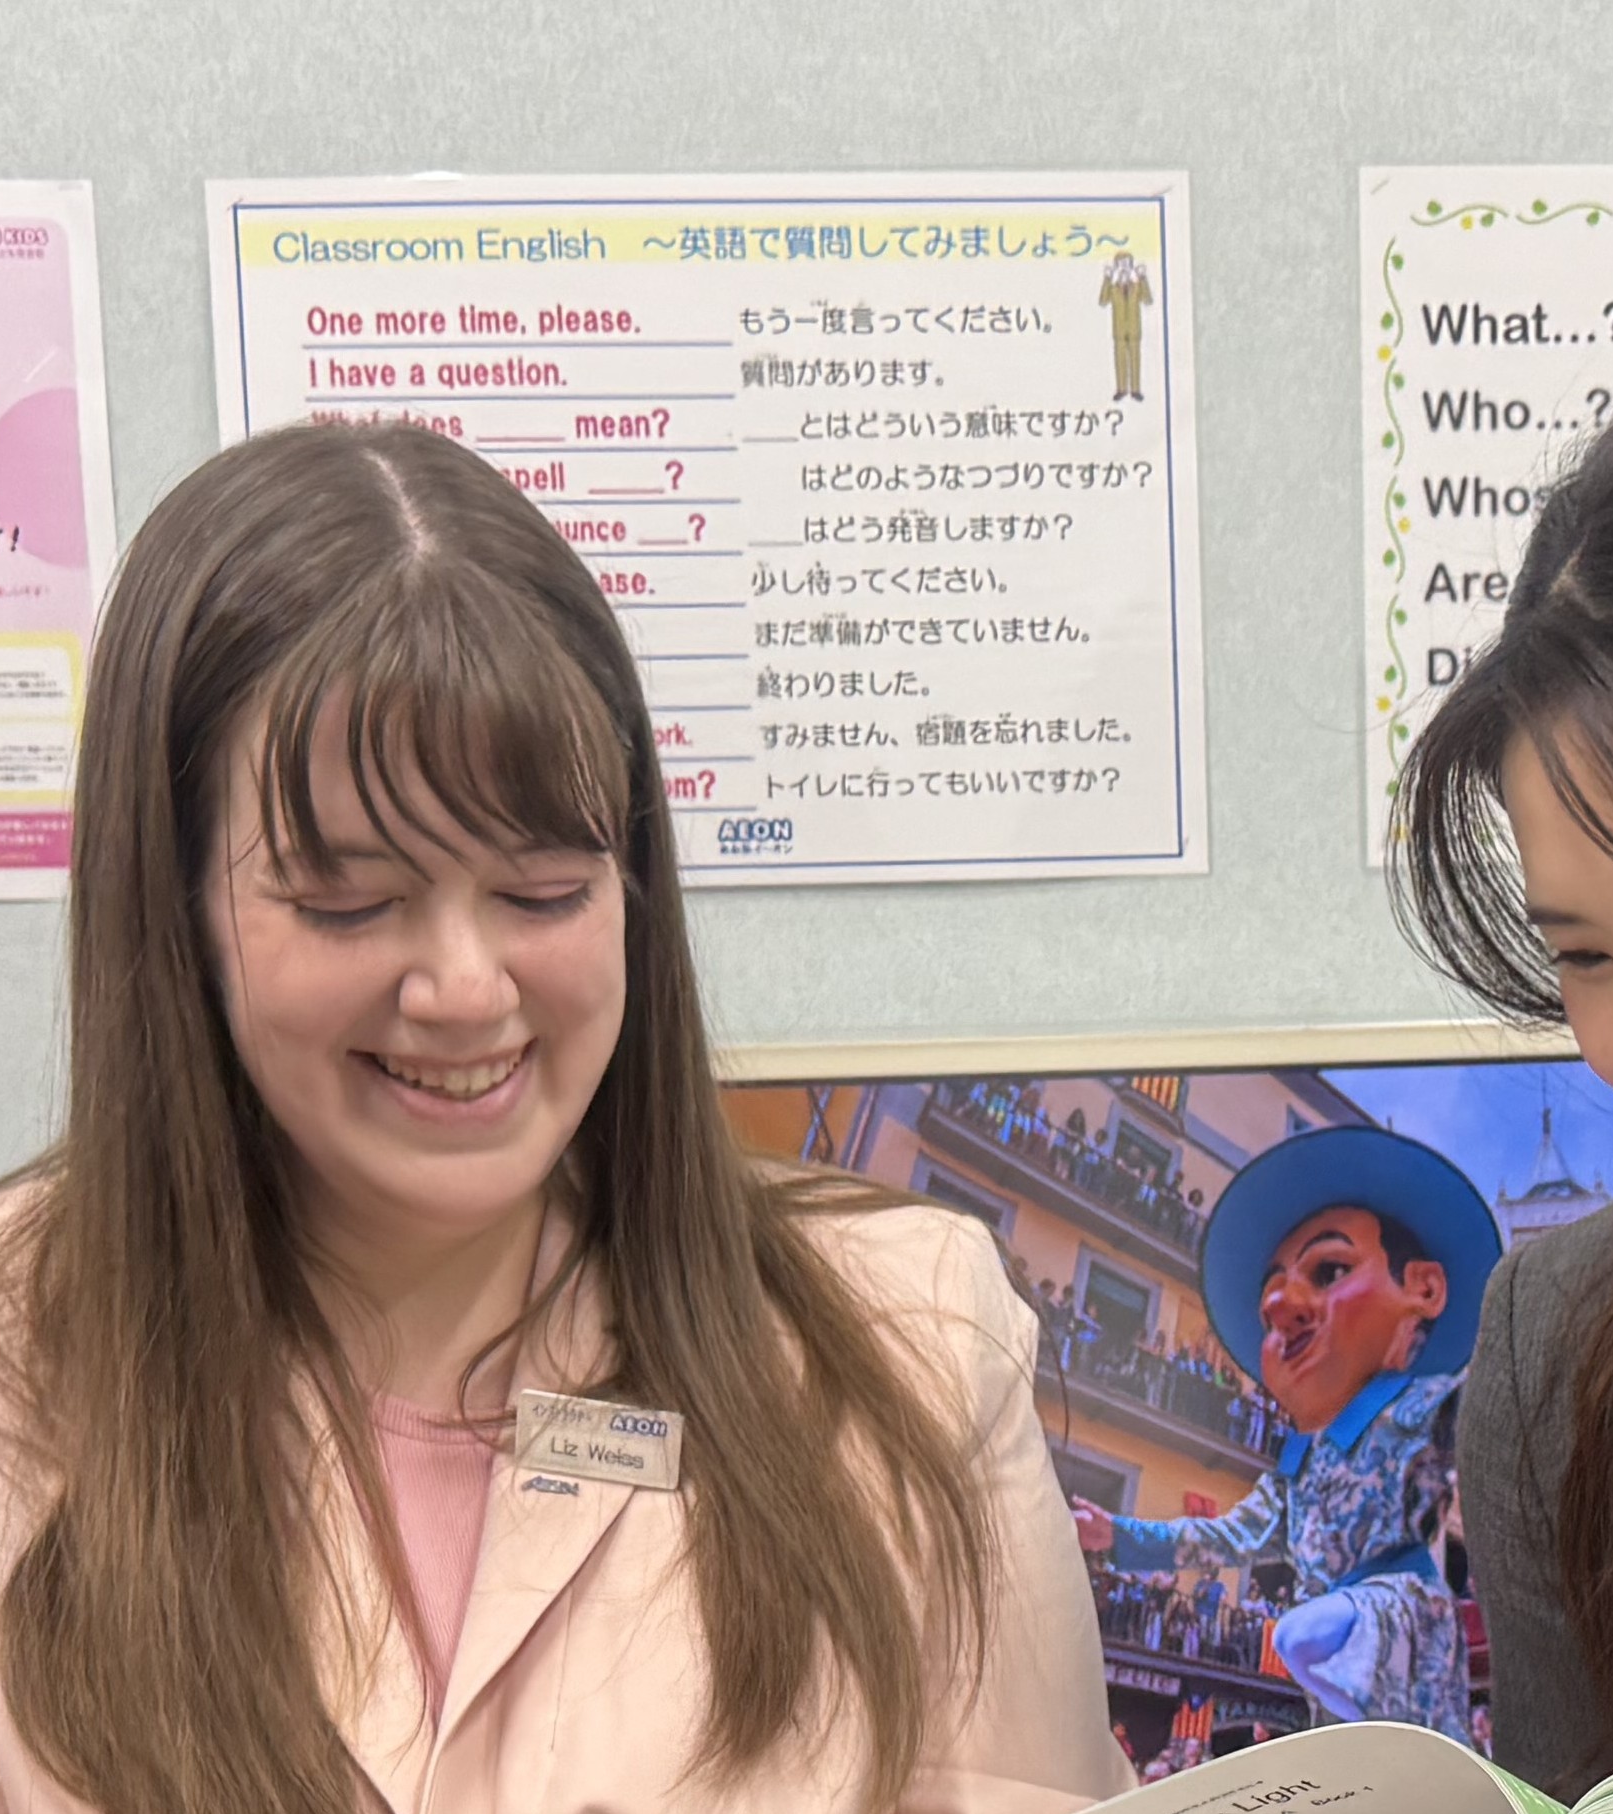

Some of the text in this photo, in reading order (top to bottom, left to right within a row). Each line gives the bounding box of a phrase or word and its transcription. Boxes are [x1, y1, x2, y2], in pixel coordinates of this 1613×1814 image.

[273, 227, 606, 263] Classroom English
[307, 304, 642, 337] One more time, please.
[739, 305, 1053, 335] もう一度言ってください。
[309, 357, 568, 390] I have a question.
[740, 358, 945, 388] 質問があります。
[575, 408, 671, 439] mean?
[1421, 388, 1613, 432] Who...?
[800, 461, 1155, 491] はどのようなつづりですか？
[555, 519, 627, 542] unce
[803, 513, 1075, 543] はどう発音しますか？
[750, 566, 1008, 596] 少し待ってください。
[1424, 562, 1509, 603] Are
[754, 617, 1091, 648] まだ準備ができていません。
[756, 671, 931, 699] 終わりました。
[762, 716, 1132, 749] すみません、宿題を忘れました。
[766, 767, 1121, 799] トイレに行ってもいいですか？
[718, 818, 793, 842] AEON
[550, 1436, 579, 1458] Liz
[1232, 1779, 1321, 1813] Light
